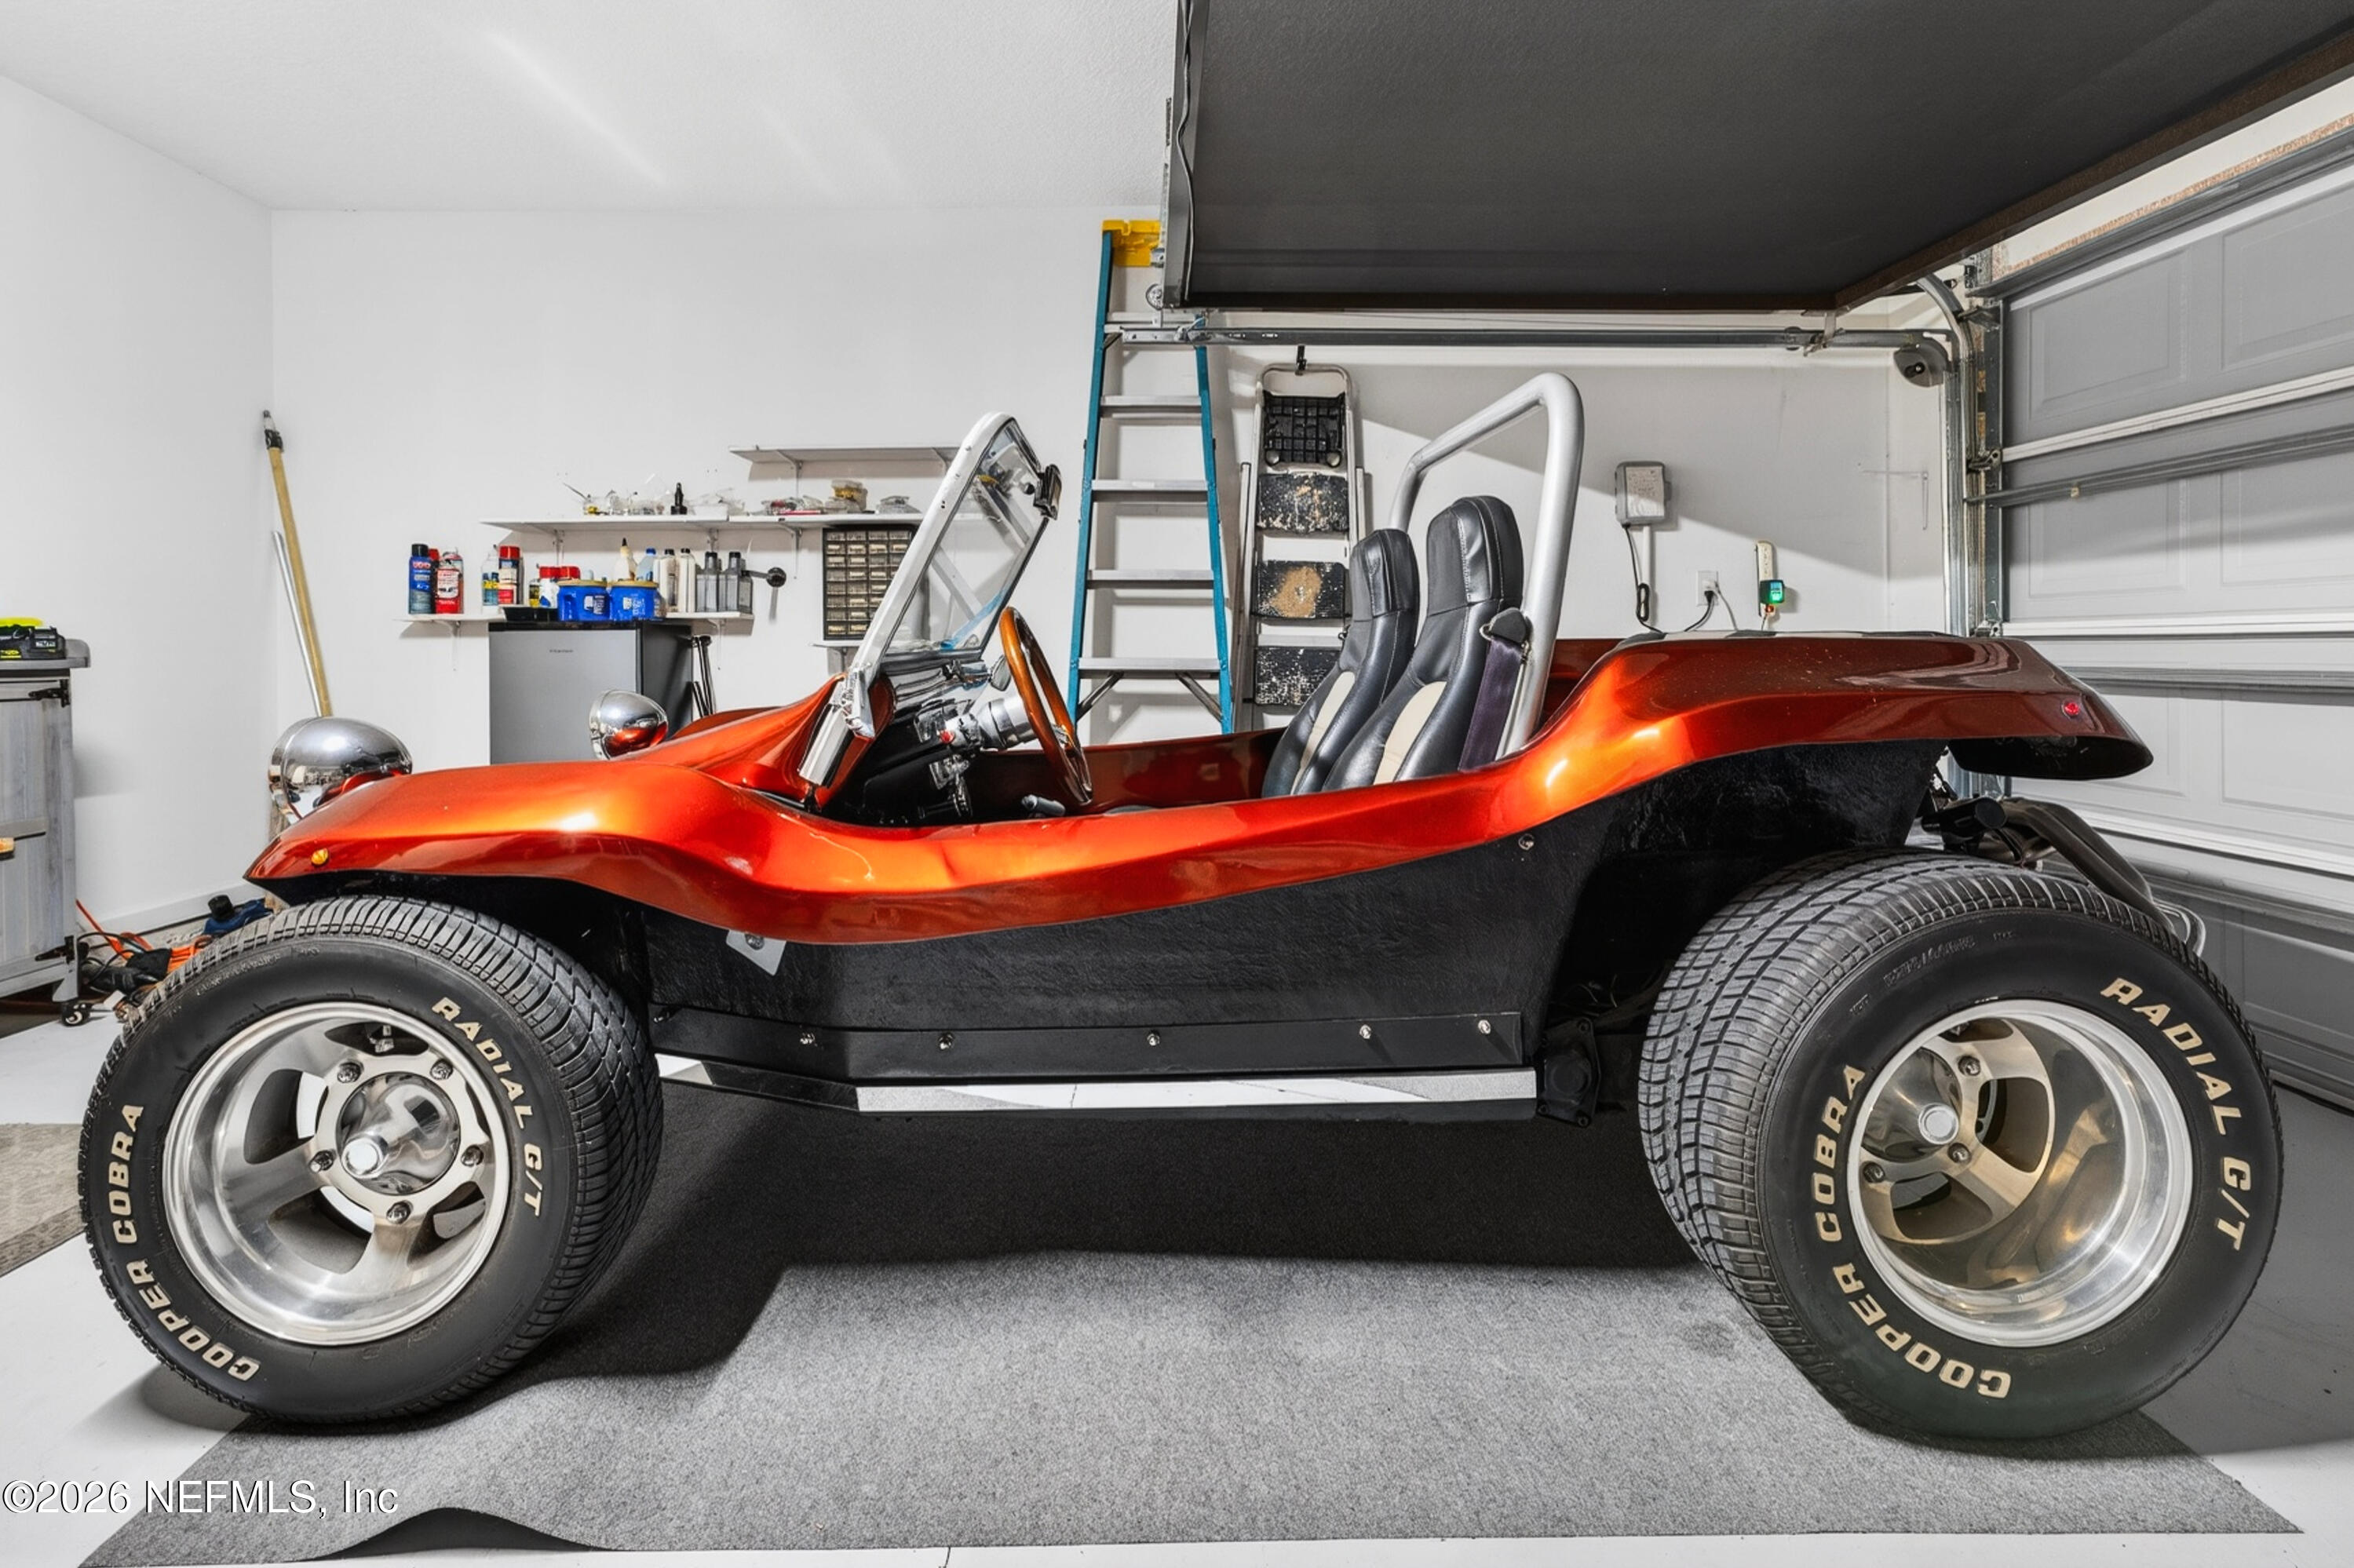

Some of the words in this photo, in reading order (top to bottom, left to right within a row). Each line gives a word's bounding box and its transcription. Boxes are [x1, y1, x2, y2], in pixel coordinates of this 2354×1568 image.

[108, 1104, 144, 1244] COBRA
[432, 997, 533, 1129] RADIAL
[524, 1143, 543, 1216] G/T
[1812, 1064, 1867, 1242] COBRA
[2100, 978, 2242, 1136] RADIAL
[2215, 1157, 2251, 1251] G/T
[126, 1259, 261, 1381] COOPER
[1833, 1263, 2012, 1398] COOPER
